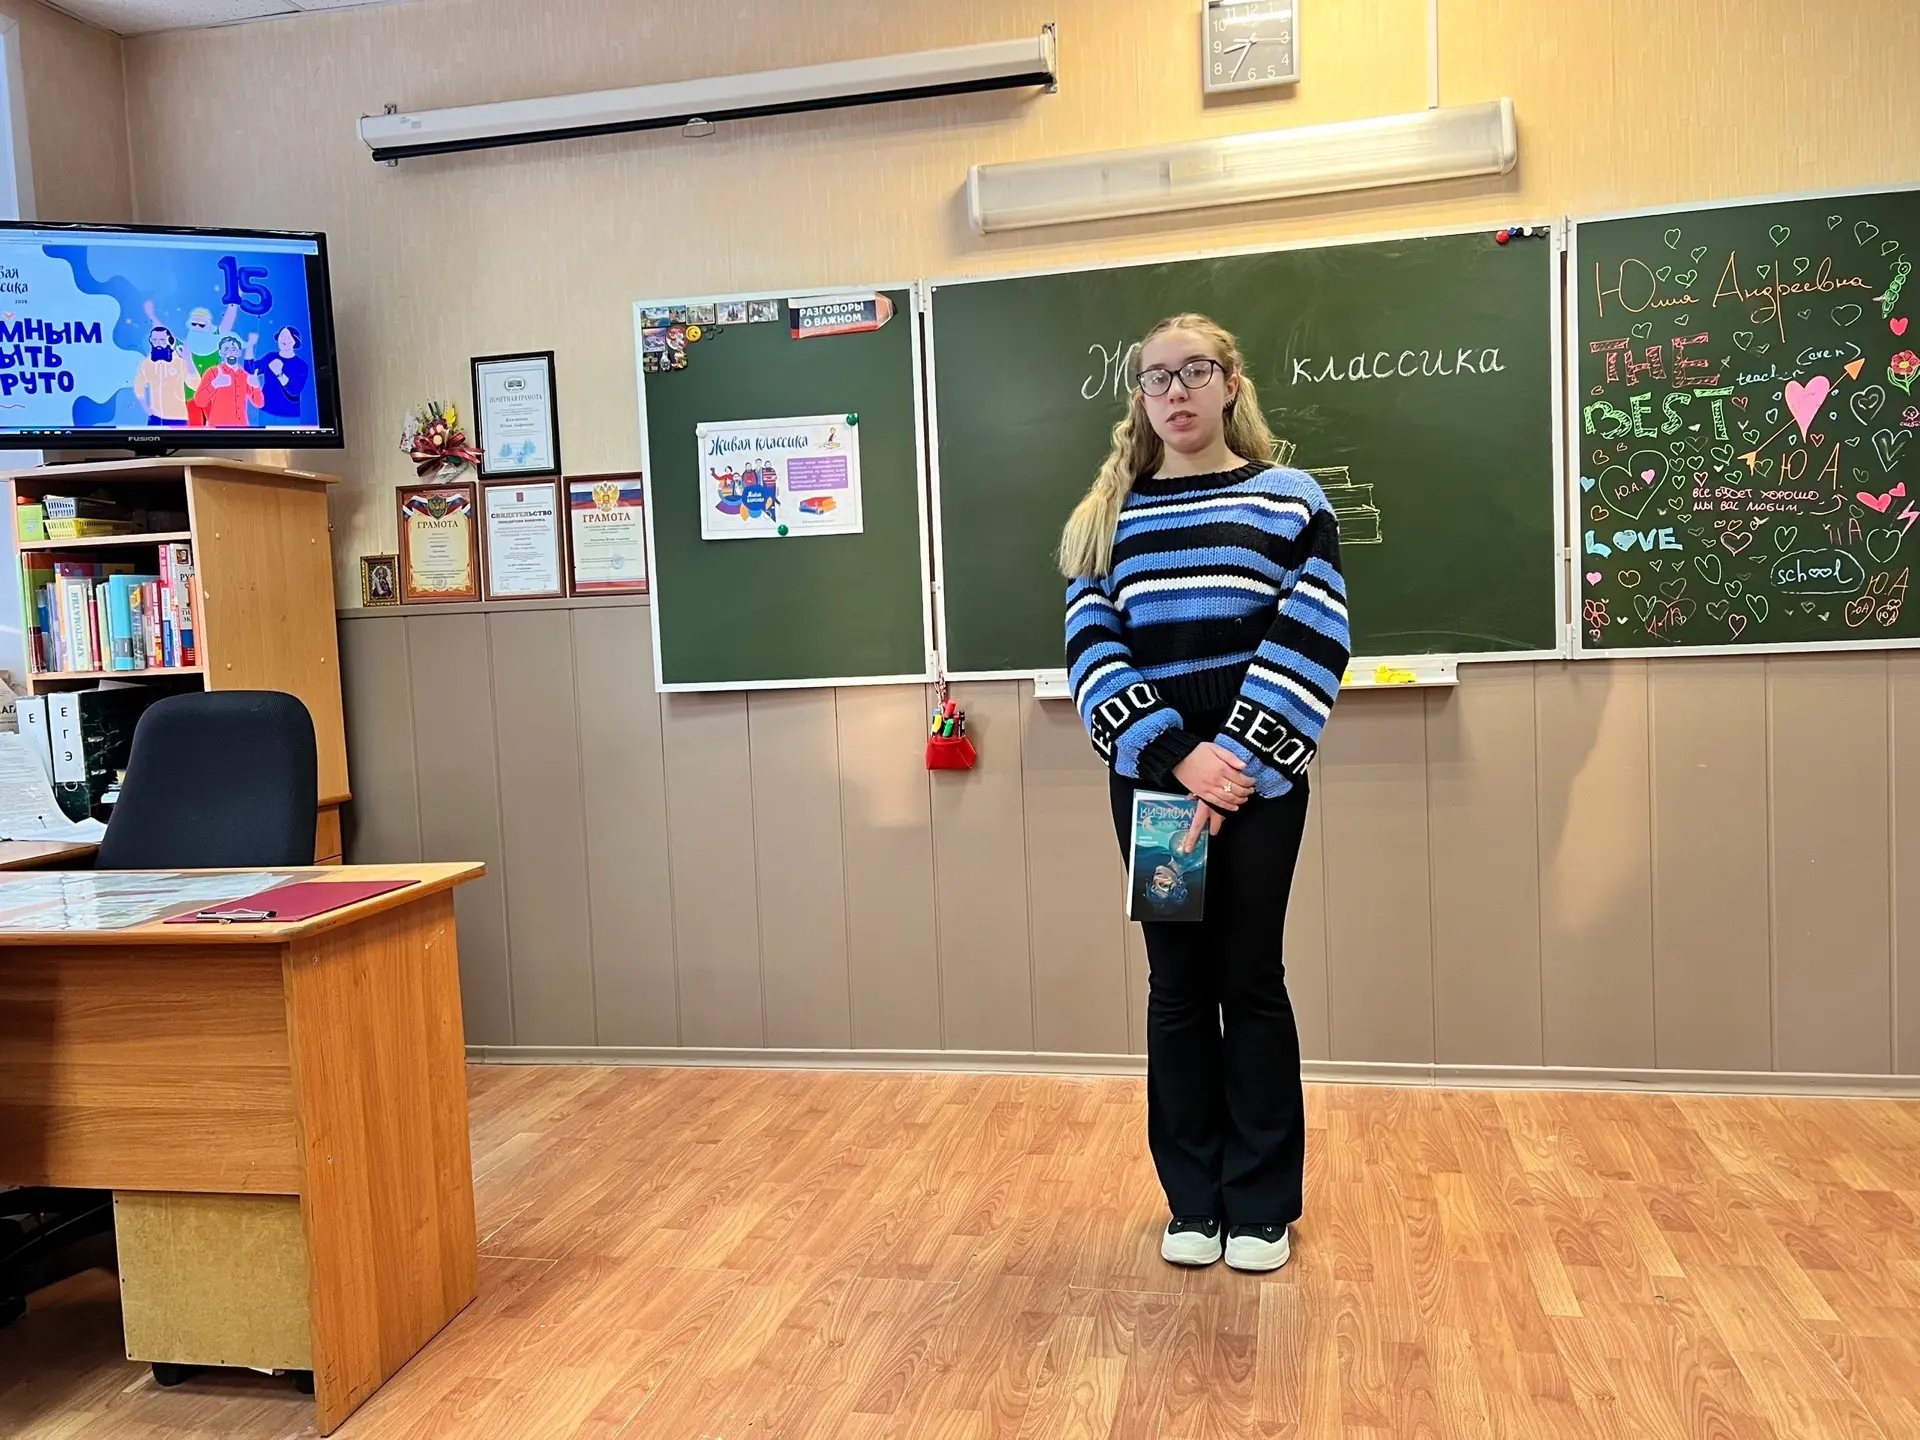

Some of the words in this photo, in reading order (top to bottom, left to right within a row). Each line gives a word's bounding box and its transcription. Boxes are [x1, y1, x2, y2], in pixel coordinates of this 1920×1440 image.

[1213, 19, 1226, 32] 10
[1280, 31, 1289, 43] 3
[1213, 40, 1222, 53] 9
[1281, 53, 1290, 66] 4
[1214, 62, 1222, 75] 8
[1248, 68, 1256, 80] 6
[1267, 65, 1276, 79] 5
[217, 255, 274, 316] 15
[1596, 258, 1699, 317] Юлия
[1712, 250, 1873, 343] Андреевна
[799, 301, 864, 317] РАЗГОВОРЫ
[804, 318, 812, 327] О
[814, 313, 862, 327] ВАЖНОМ
[1292, 347, 1507, 385] классика
[1589, 332, 1720, 388] THE
[0, 370, 75, 396] РУТО
[1584, 386, 1735, 441] BEST
[708, 435, 751, 456] Живая
[755, 434, 808, 451] классика
[491, 510, 552, 519] СВИДЕТЕЛЬСТВО
[583, 512, 631, 523] ГРАМОТА
[417, 520, 458, 529] ГРАМОТА
[1585, 527, 1683, 558] LOVE
[1777, 558, 1853, 584] school
[71, 592, 84, 658] ХРЕСТОМАТИЯ
